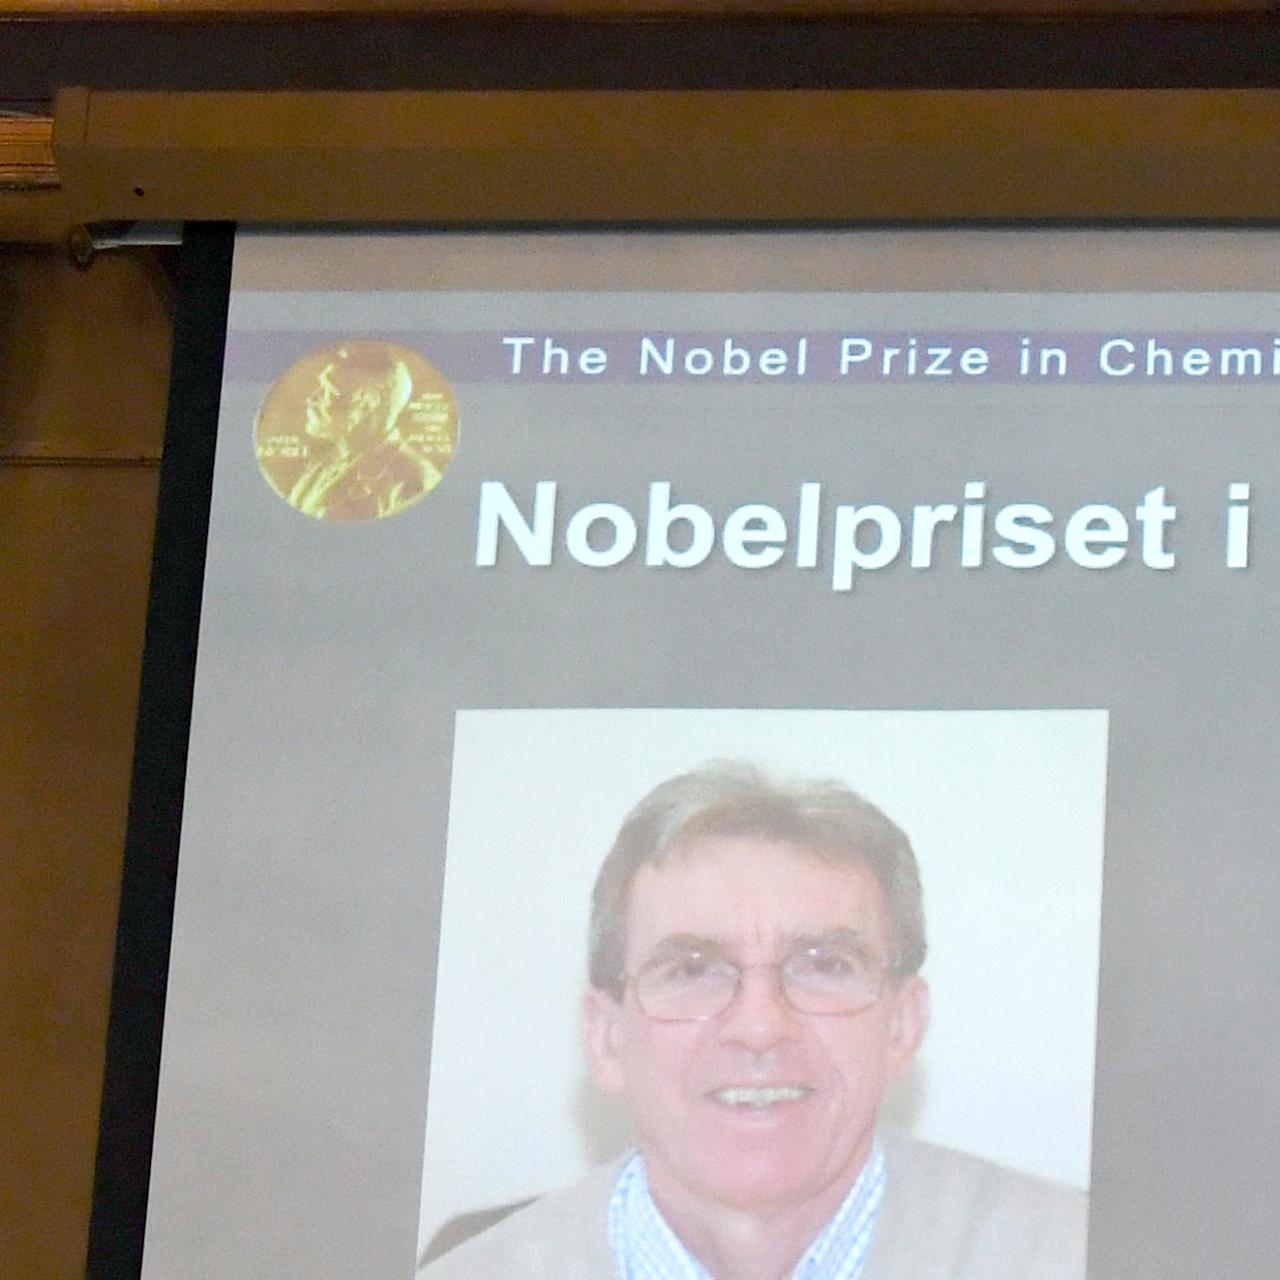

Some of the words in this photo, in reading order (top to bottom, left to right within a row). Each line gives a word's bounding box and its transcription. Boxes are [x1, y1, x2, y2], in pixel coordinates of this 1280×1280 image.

[502, 337, 608, 375] The
[639, 337, 807, 376] Nobel
[840, 338, 989, 376] Prize
[1020, 338, 1067, 376] in
[475, 480, 1177, 591] Nobelpriset
[1226, 482, 1250, 568] i
